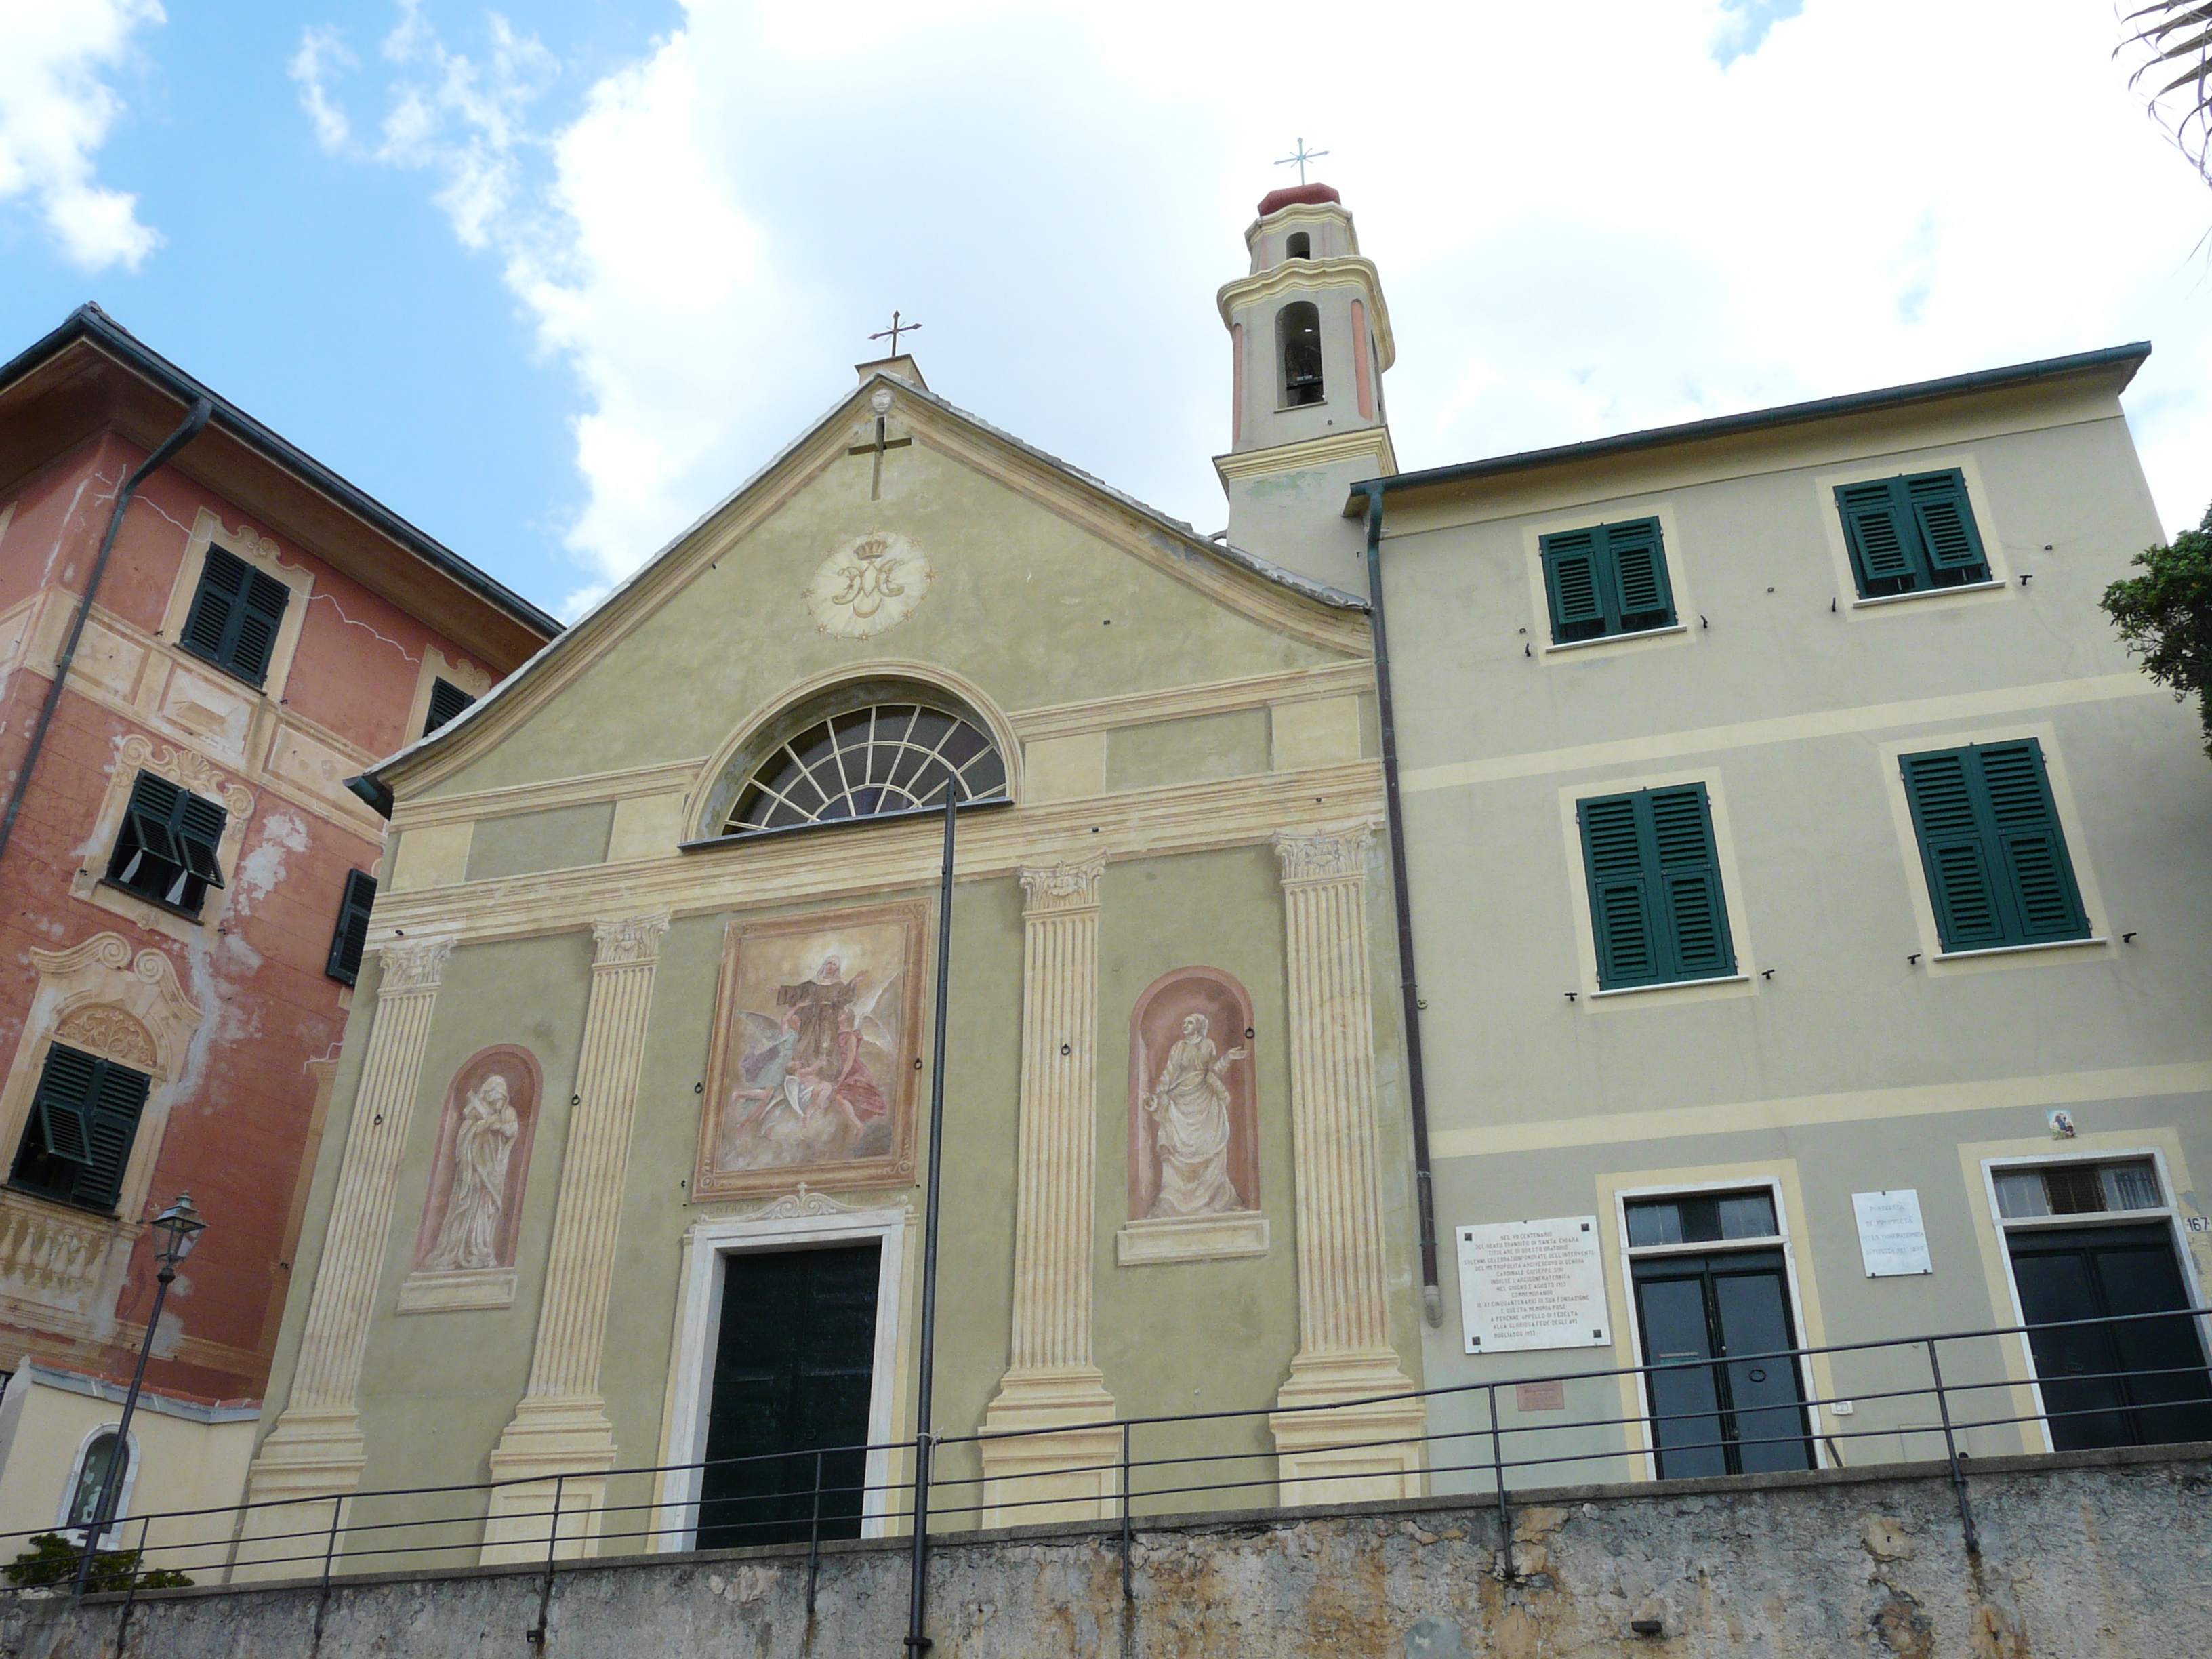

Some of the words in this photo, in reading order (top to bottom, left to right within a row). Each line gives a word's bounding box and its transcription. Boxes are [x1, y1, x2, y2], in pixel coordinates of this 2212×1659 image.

[2186, 1217, 2207, 1231] 167
[1491, 1298, 1536, 1307] CINQUANTENARIO
[1557, 1294, 1589, 1303] FONDAZIONE
